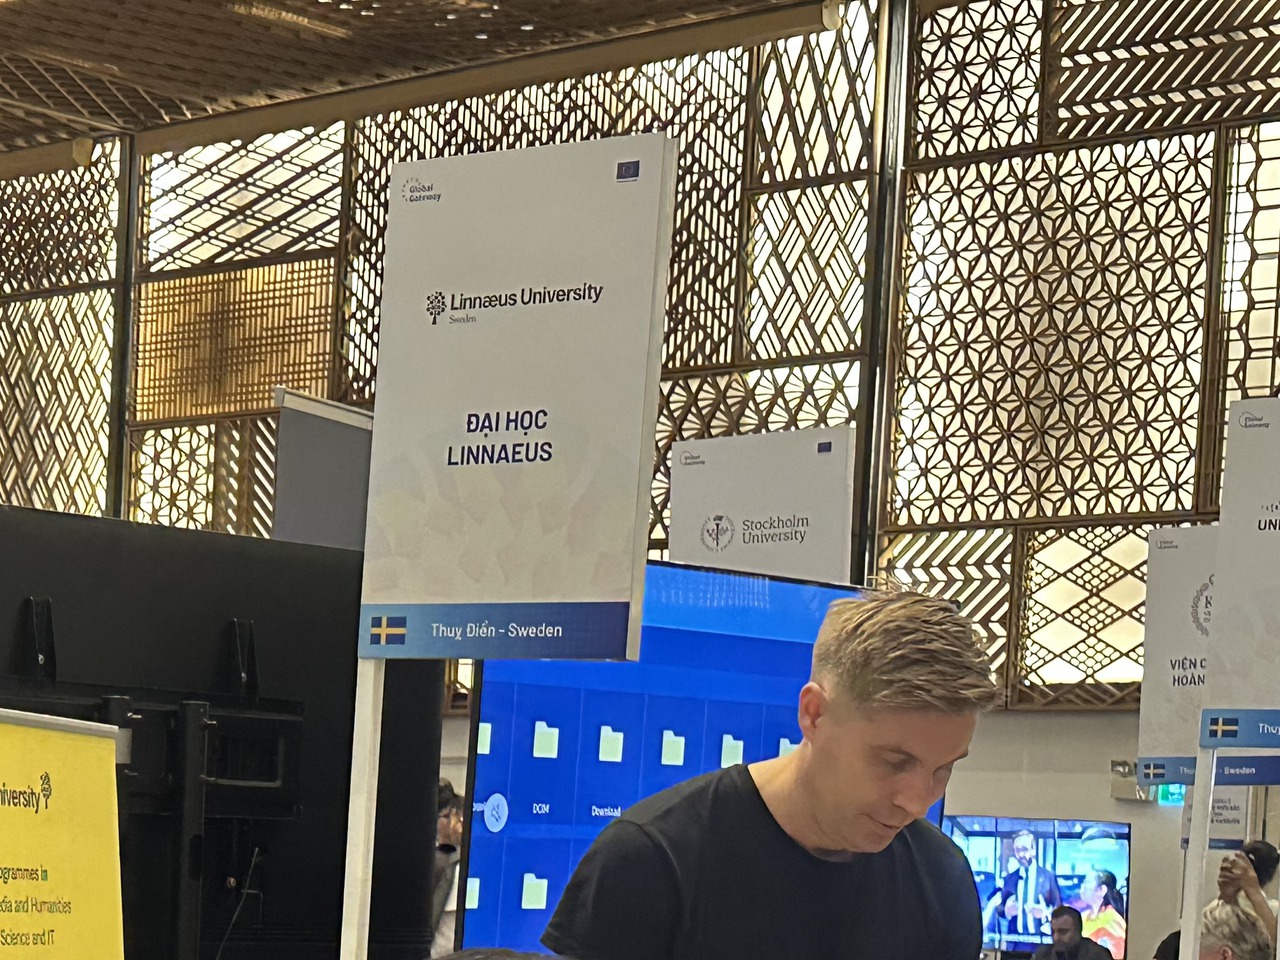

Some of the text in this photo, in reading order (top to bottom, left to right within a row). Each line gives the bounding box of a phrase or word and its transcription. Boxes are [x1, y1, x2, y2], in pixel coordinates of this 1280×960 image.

[450, 282, 603, 311] Linnæus University
[449, 313, 477, 325] Sweden
[466, 410, 549, 438] ĐẠI HỌC
[447, 442, 553, 466] LINNAEUS
[742, 515, 809, 532] Stockholm
[742, 529, 806, 544] University
[508, 623, 563, 637] Sweden
[41, 864, 48, 881] in
[14, 896, 29, 913] and
[30, 897, 71, 914] Humanities
[0, 928, 30, 946] Science
[32, 929, 46, 945] and
[47, 929, 55, 945] IT
